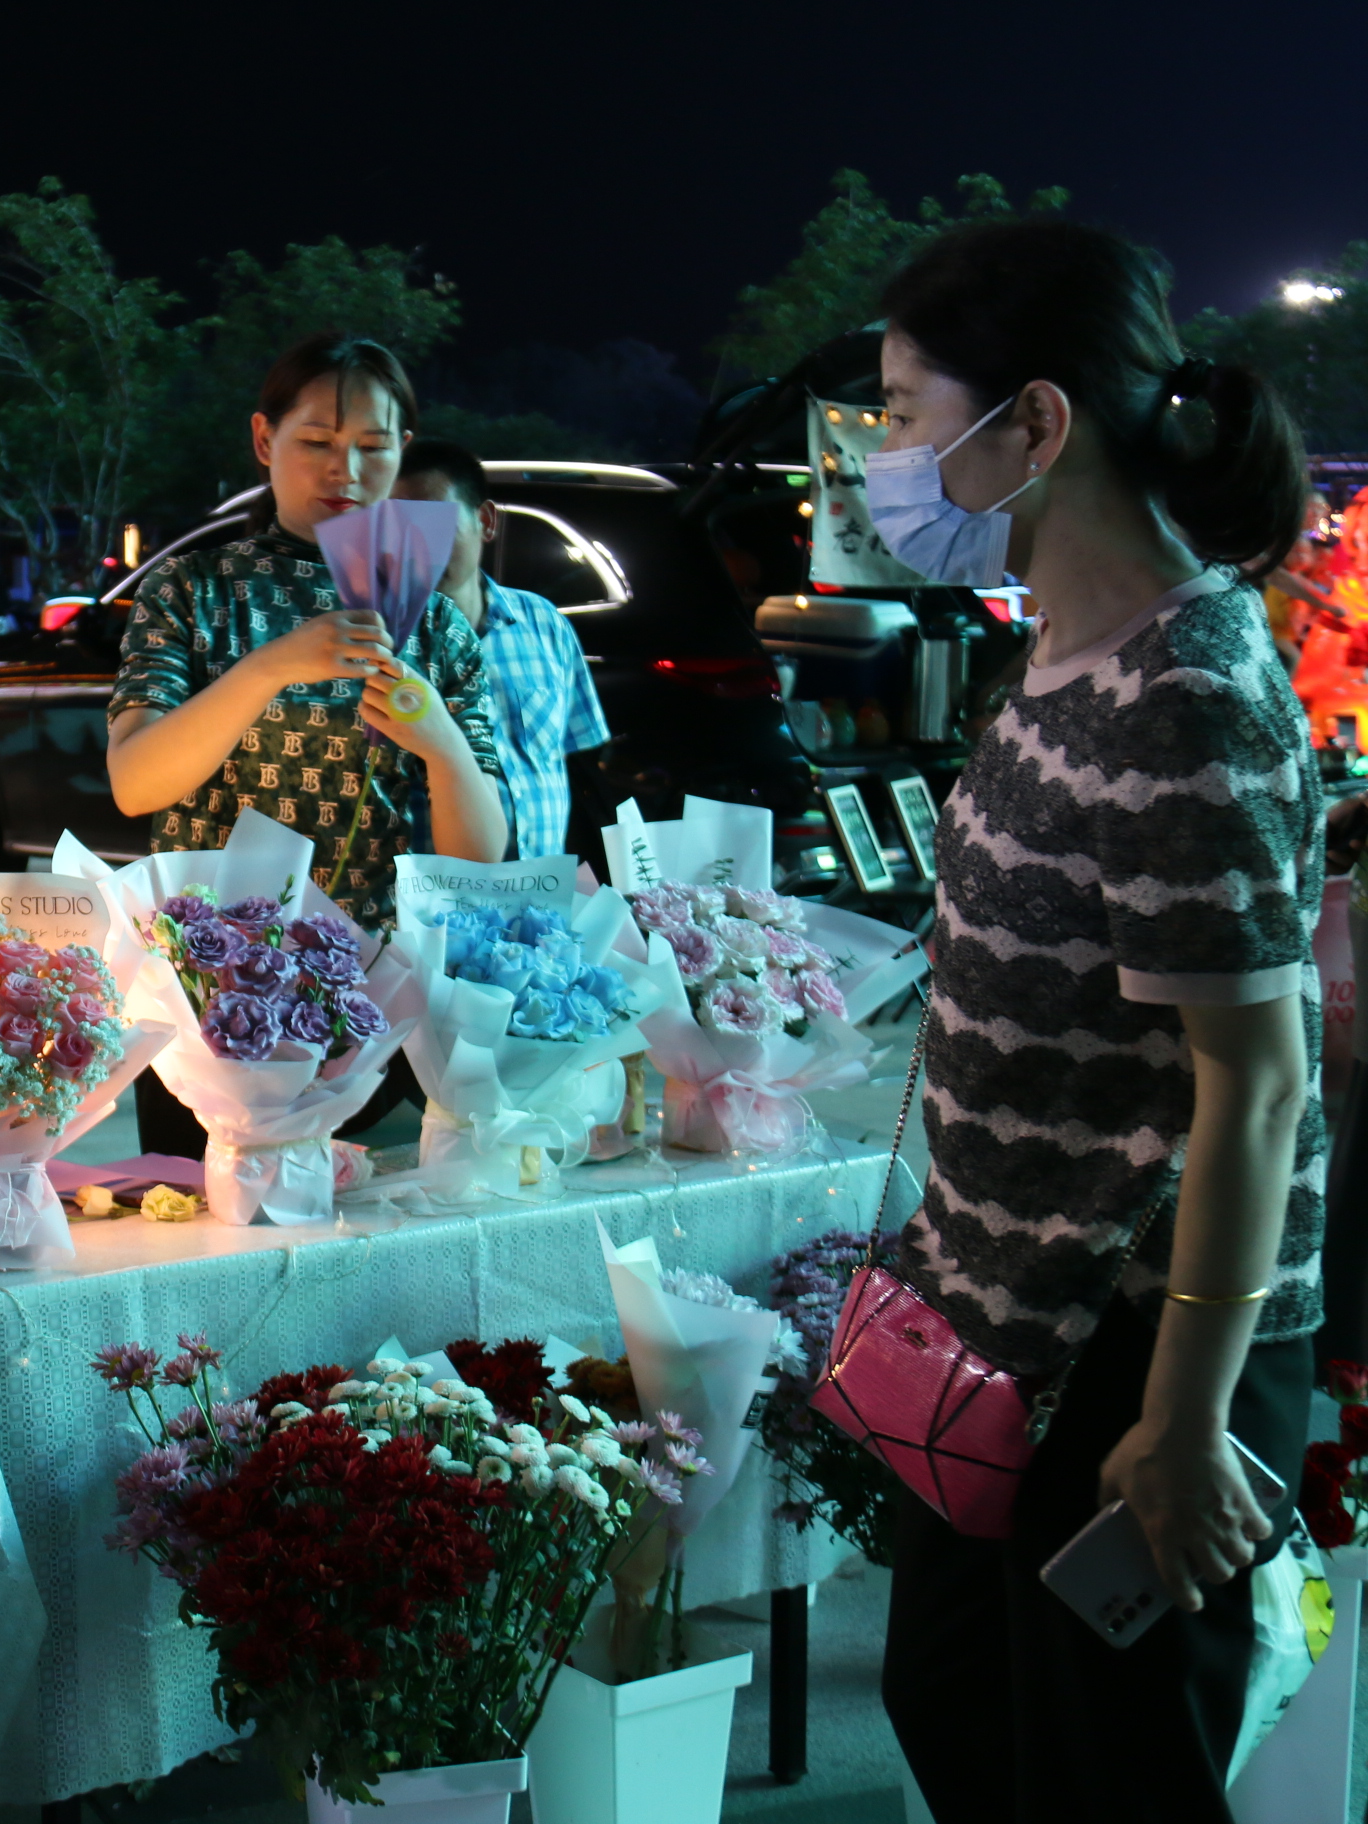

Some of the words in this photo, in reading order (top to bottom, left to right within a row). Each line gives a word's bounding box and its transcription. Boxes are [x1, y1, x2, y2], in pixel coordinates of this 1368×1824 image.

[411, 874, 487, 893] FLOWERS
[492, 874, 559, 893] STUDIO
[19, 895, 94, 916] STUDIO
